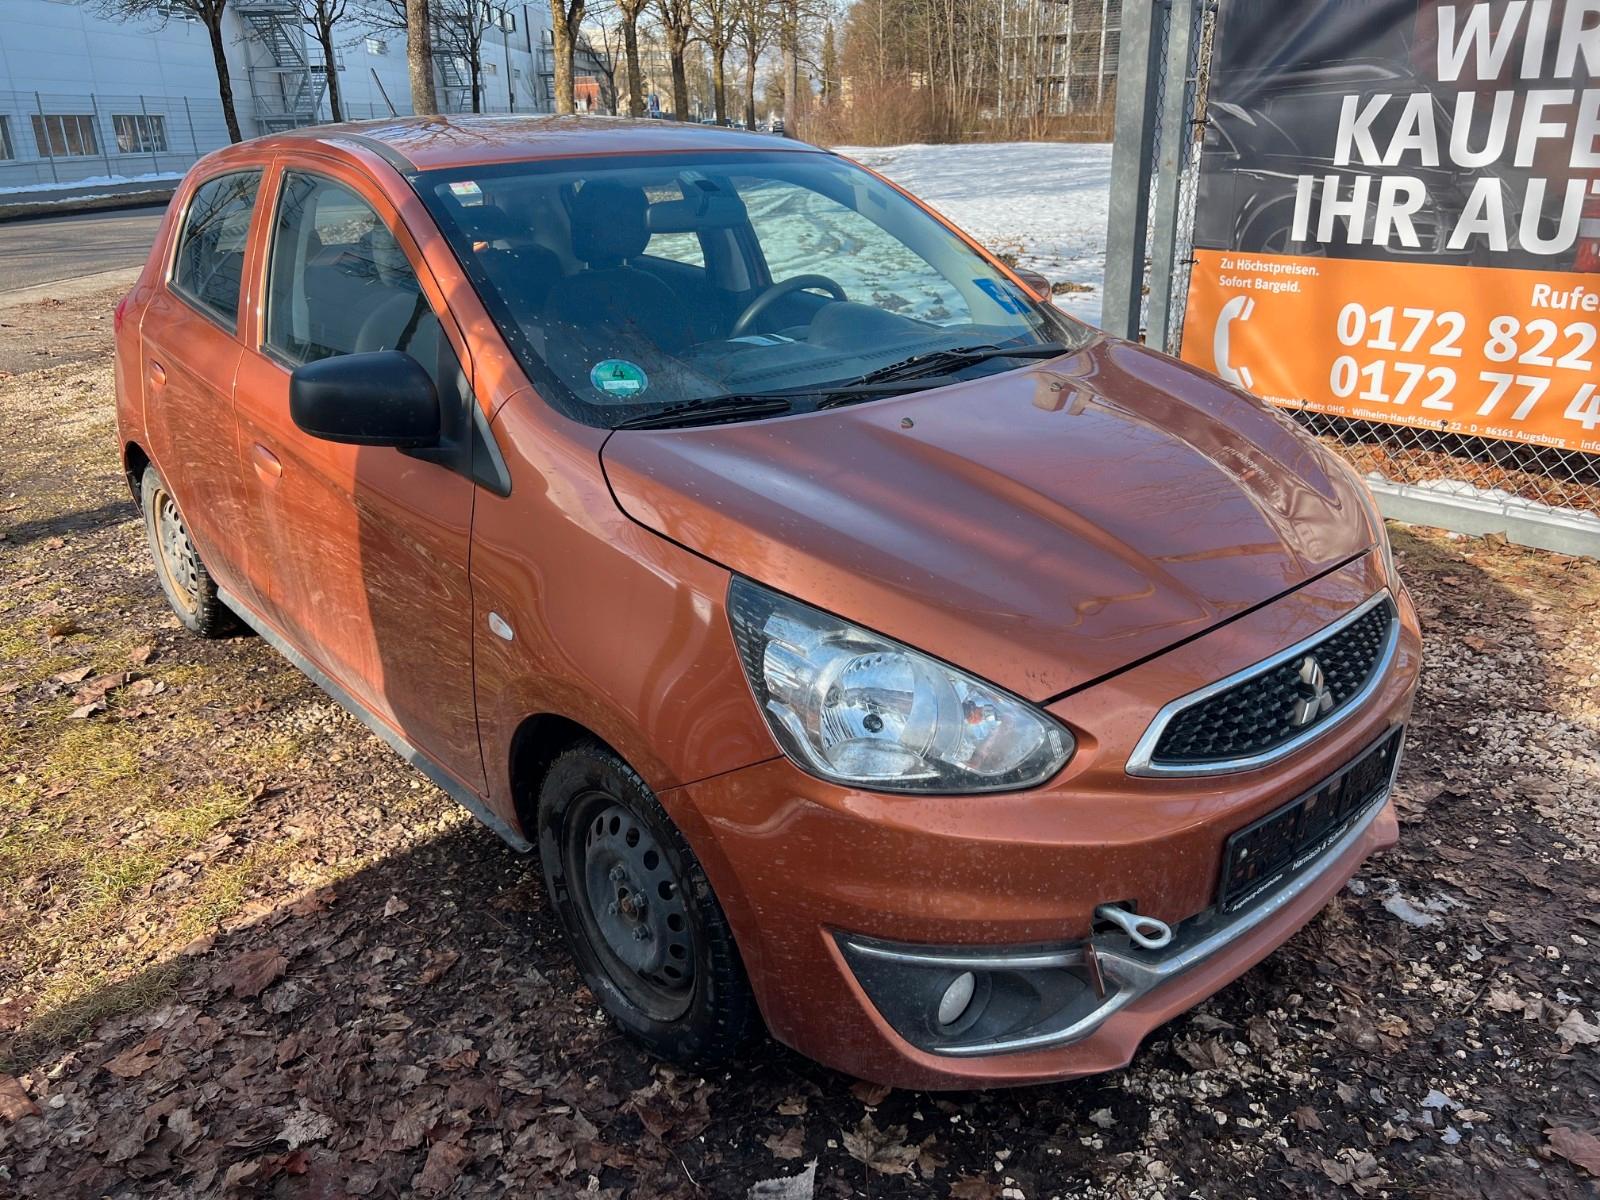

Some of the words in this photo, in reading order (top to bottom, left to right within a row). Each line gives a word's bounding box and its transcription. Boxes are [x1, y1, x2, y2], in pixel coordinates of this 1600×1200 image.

[1437, 0, 1600, 82] WIR
[1333, 88, 1600, 169] KAUFE
[1290, 175, 1427, 248] IHR
[1446, 177, 1600, 255] AU
[1219, 275, 1252, 289] Sofort
[1254, 278, 1301, 294] Bargeld.
[1220, 257, 1234, 270] Zu
[1236, 258, 1320, 276] Höchstpreisen.
[1531, 283, 1600, 312] Rufe
[1336, 302, 1466, 358] 0172
[1483, 315, 1597, 371] 822
[1329, 355, 1457, 411] 0172
[1475, 371, 1551, 421] 77
[1327, 403, 1345, 415] OHG
[1352, 407, 1448, 428] Wilhelm-Hauff-Straß
[1450, 421, 1461, 431] 22
[1485, 426, 1514, 438] 86161
[1515, 430, 1566, 447] Augsburg
